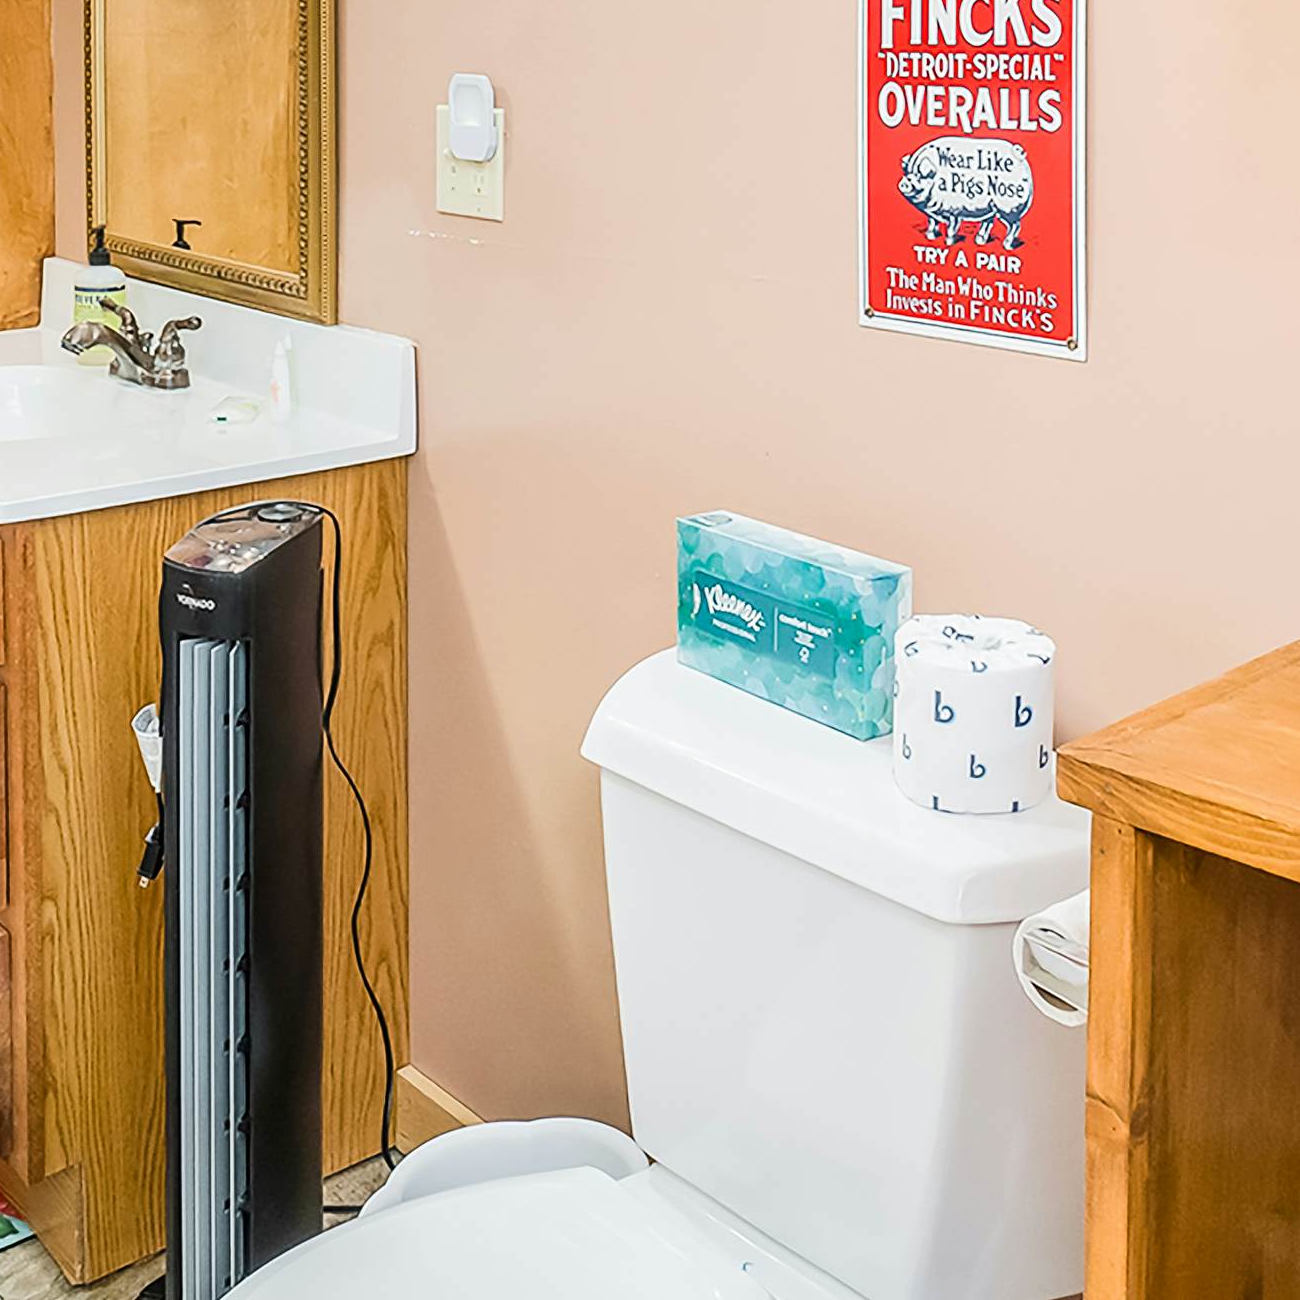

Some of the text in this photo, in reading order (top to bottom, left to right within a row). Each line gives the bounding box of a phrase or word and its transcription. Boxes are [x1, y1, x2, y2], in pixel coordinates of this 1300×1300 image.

[877, 82, 1063, 133] OVERALLS
[977, 148, 1014, 174] Like
[938, 178, 948, 192] a
[950, 173, 985, 200] Pigs
[913, 245, 1022, 274] TRY A PAIR
[885, 267, 1058, 310] The Man Who Thinks
[885, 288, 1055, 333] Invests in FINCK'S
[934, 689, 954, 724] b
[1014, 695, 1033, 728] b
[902, 732, 912, 759] b
[1038, 743, 1049, 769] b
[969, 753, 987, 779] b
